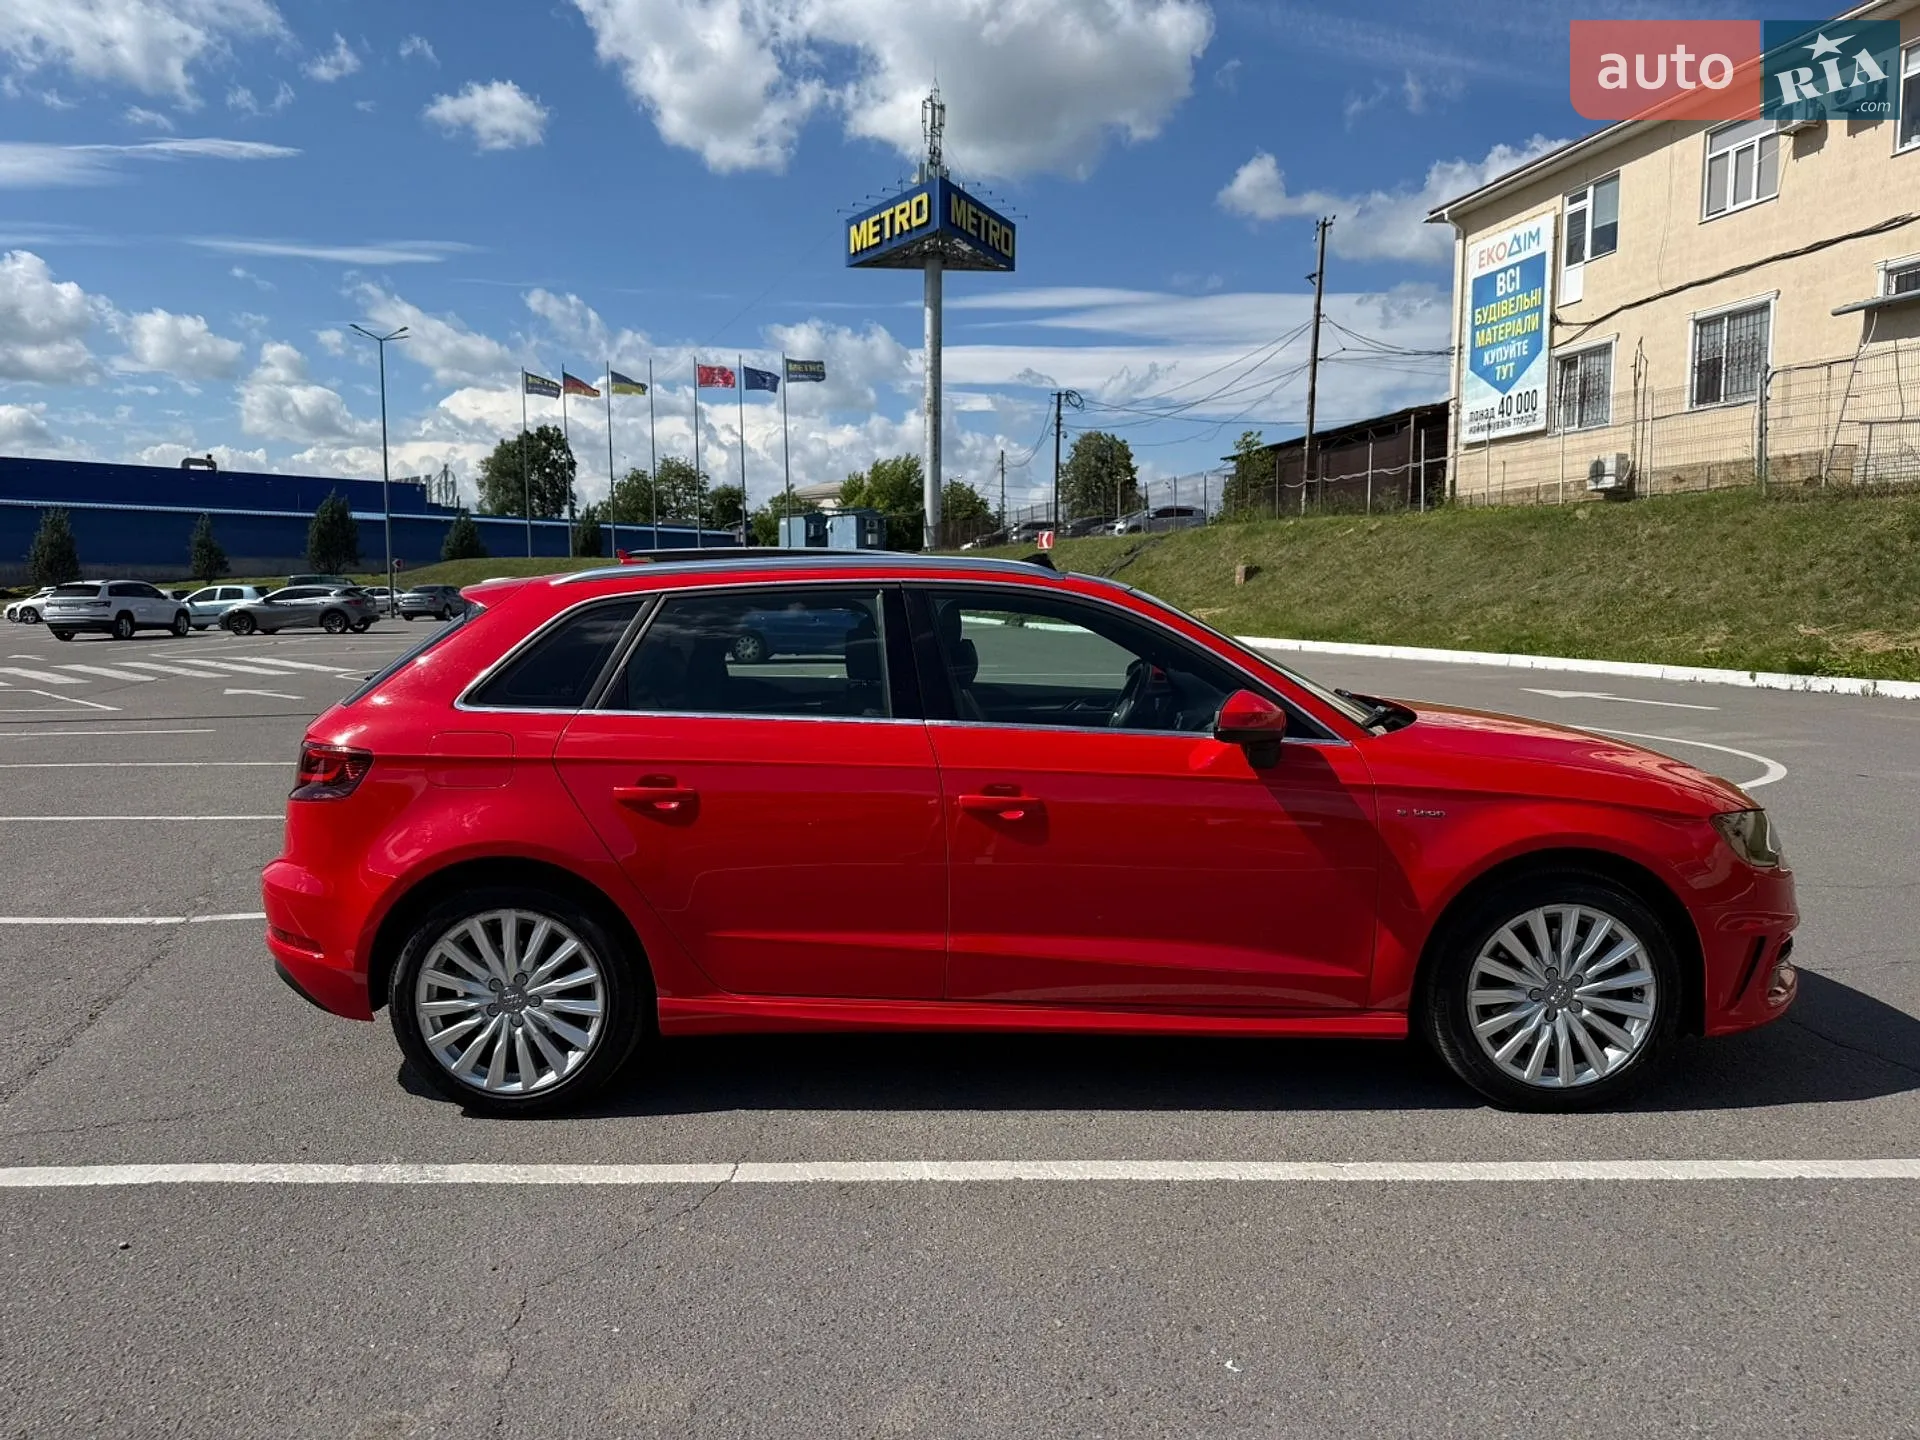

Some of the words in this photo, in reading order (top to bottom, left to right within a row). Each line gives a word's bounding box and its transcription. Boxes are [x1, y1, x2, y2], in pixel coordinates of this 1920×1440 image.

[850, 192, 929, 255] METRO
[951, 194, 1013, 257] METRO
[1496, 266, 1520, 297] ВСІ
[1475, 287, 1542, 326] БУДІВЕЛЬНІ
[1475, 312, 1540, 349] МАТЕРІАЛИ
[1483, 339, 1529, 367] КУПУЙТЕ
[1495, 362, 1516, 381] ТУТ
[1498, 394, 1513, 418] 40
[1516, 388, 1538, 415] 000
